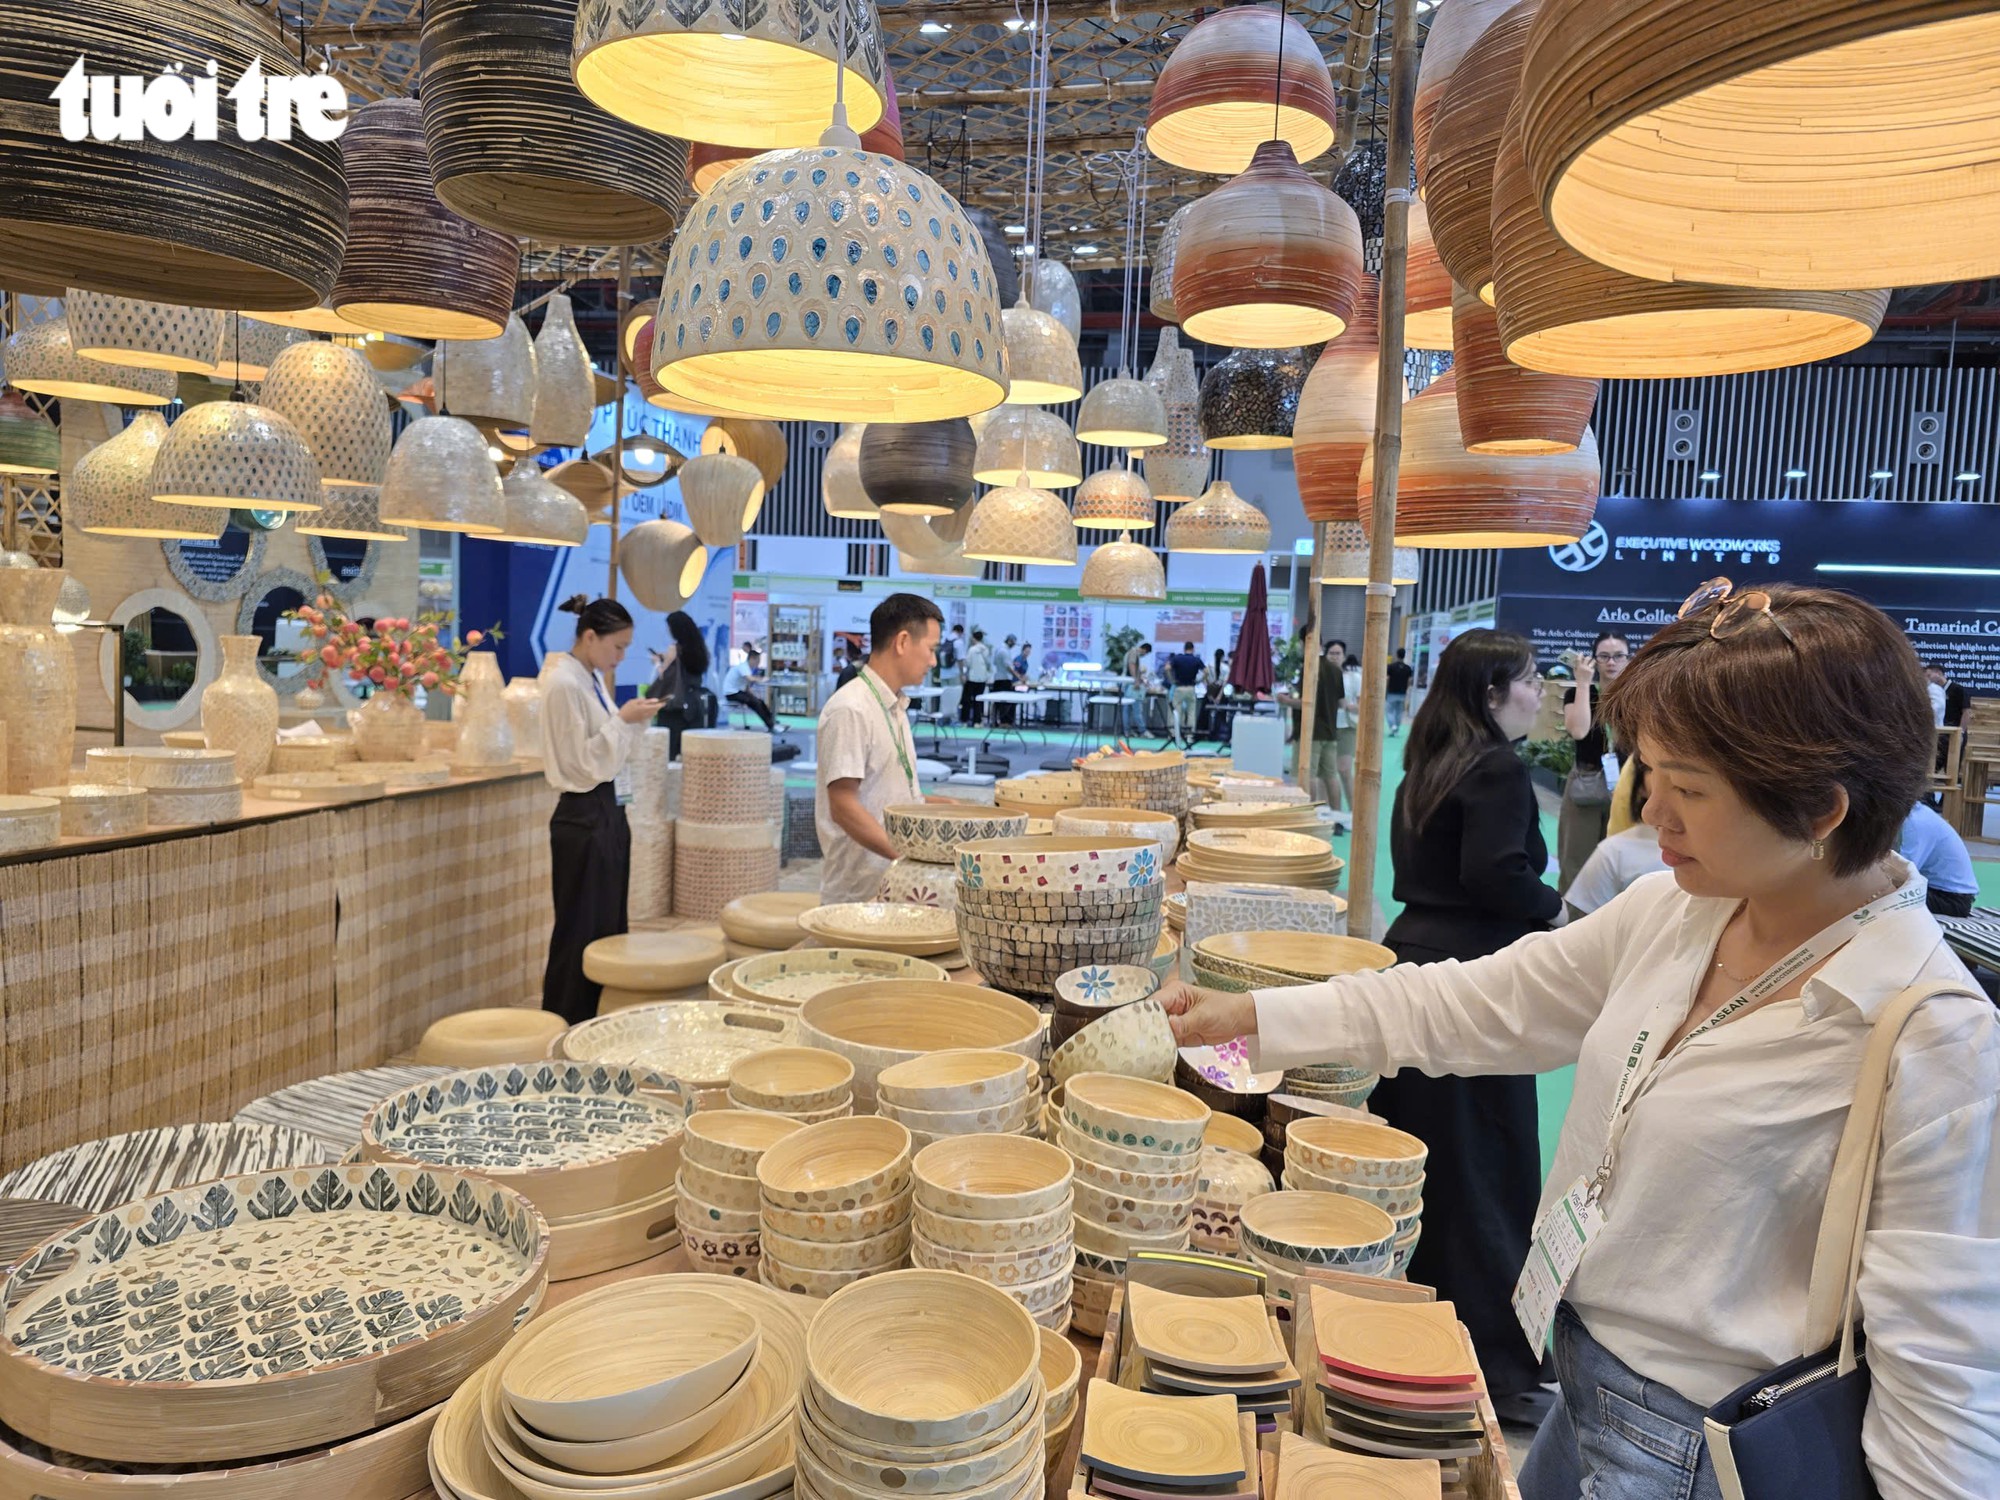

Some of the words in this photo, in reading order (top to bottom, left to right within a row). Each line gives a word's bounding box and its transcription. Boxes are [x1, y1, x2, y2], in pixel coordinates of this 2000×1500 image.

[1615, 536, 1688, 550] EXECUTIVE
[1689, 538, 1781, 552] WOODWORKS
[1615, 550, 1780, 565] LIMITED
[1597, 607, 1630, 621] Arlo
[1634, 608, 1679, 622] Collec
[1532, 629, 1547, 637] The
[1905, 618, 1980, 633] Tamarind
[1950, 642, 1987, 652] highlights
[1920, 652, 1959, 660] expressive
[1960, 653, 1980, 661] grain
[1944, 661, 1974, 669] elevated
[1976, 662, 1985, 671] by
[1957, 670, 1970, 678] and
[1972, 671, 1994, 679] visual
[1749, 966, 1785, 994] INTERNATIONAL
[1759, 982, 1774, 995] HOME
[1710, 996, 1749, 1026] ASEAN
[1571, 1189, 1589, 1224] VISITOR
